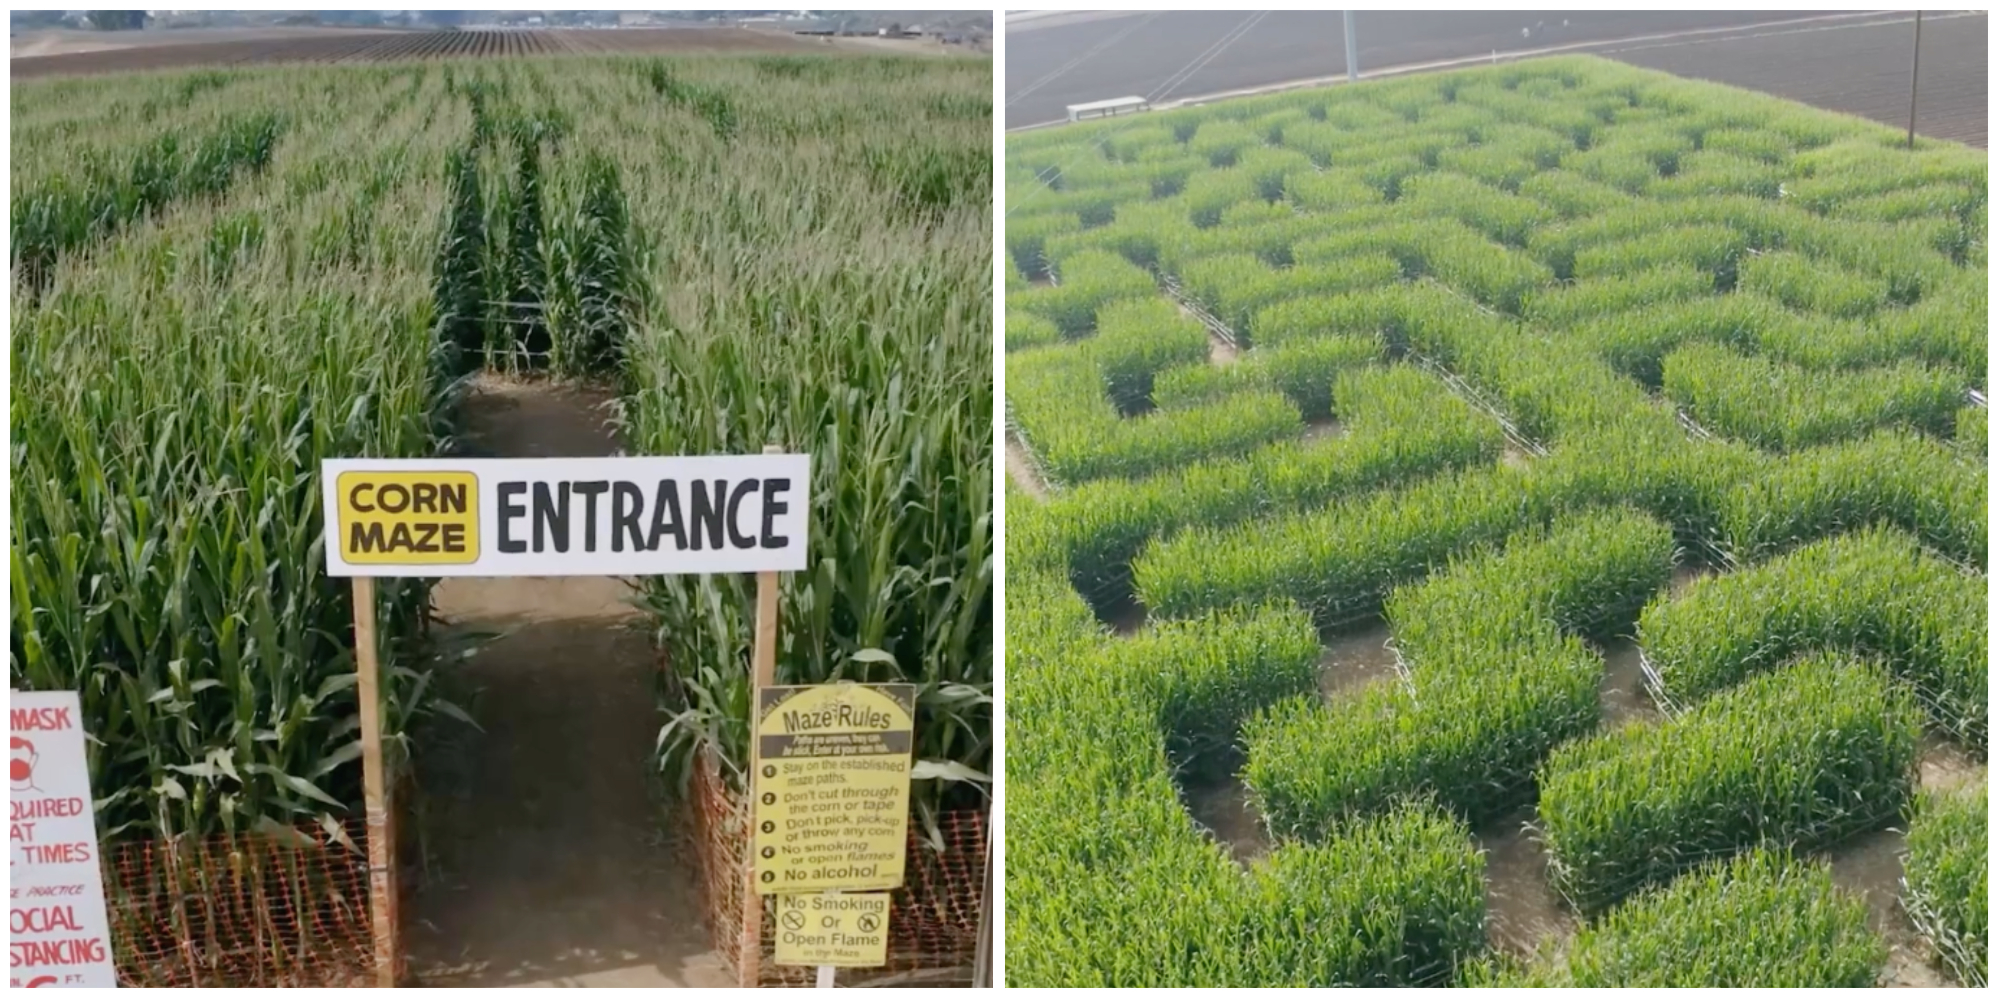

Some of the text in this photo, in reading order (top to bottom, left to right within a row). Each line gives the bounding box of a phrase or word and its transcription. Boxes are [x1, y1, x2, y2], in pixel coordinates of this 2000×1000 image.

[349, 482, 467, 514] CORN
[496, 478, 791, 554] ENTRANCE
[349, 522, 465, 553] MAZE
[10, 707, 72, 731] MASK
[783, 704, 891, 733] Maze Rules
[783, 762, 804, 774] Stay
[806, 761, 819, 771] on
[822, 759, 838, 770] the
[840, 759, 905, 773] established
[788, 773, 847, 786] maze paths.
[784, 790, 816, 803] Don't
[818, 787, 839, 799] cut
[842, 785, 899, 799] through
[790, 799, 895, 814] the corn or tape
[856, 813, 900, 827] pick-up
[10, 822, 36, 842] AT
[785, 832, 799, 843] or
[802, 828, 840, 839] throw
[843, 826, 866, 838] any
[21, 842, 90, 864] TIMES
[782, 845, 800, 855] No
[804, 840, 868, 853] smoking
[791, 851, 895, 865] or open flames
[784, 869, 807, 882] No
[812, 864, 878, 879] alcohol
[26, 884, 85, 897] PRACTICE
[784, 896, 884, 912] No Smoking
[10, 905, 84, 934] OCIAL
[821, 915, 841, 928] Or
[783, 931, 879, 946] Open Flame
[815, 948, 831, 957] the
[834, 948, 859, 957] Maze
[65, 974, 85, 984] FT.
